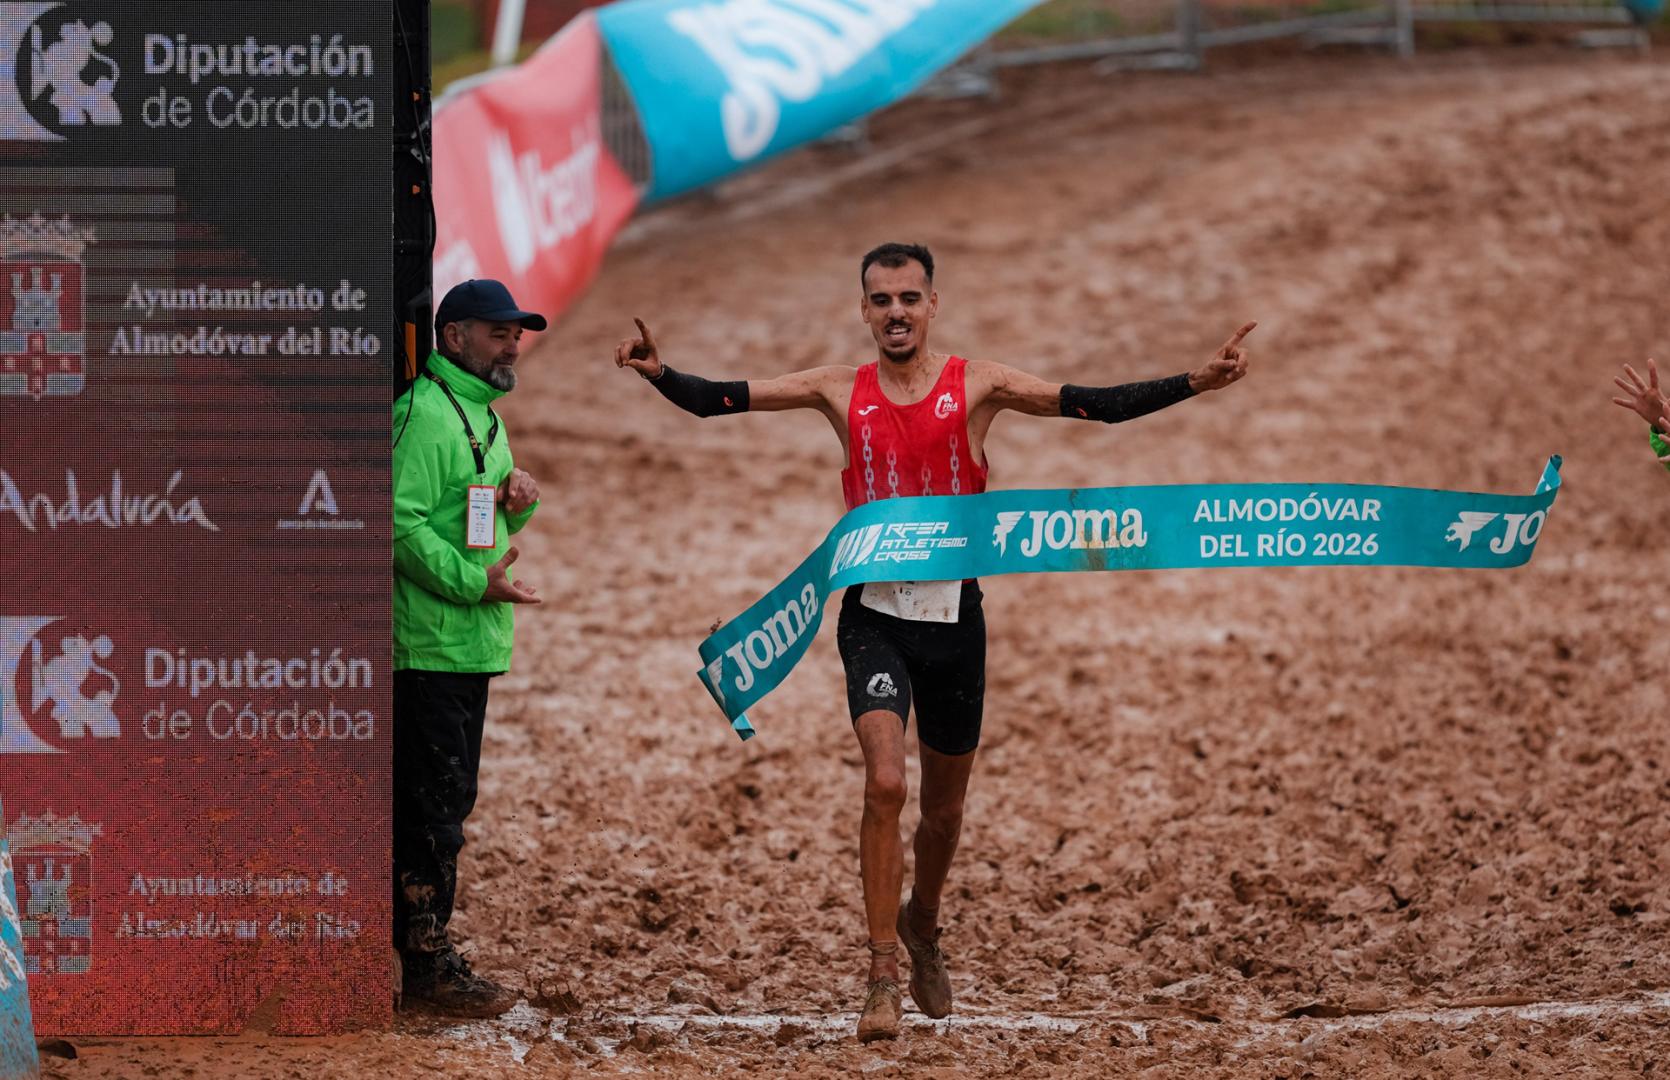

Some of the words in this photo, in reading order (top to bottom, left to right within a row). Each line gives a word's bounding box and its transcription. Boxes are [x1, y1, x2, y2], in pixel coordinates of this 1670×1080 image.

[144, 33, 374, 84] Diputación
[142, 87, 193, 129] de
[206, 86, 375, 129] Córdoba
[122, 281, 325, 317] Ayuntamiento
[331, 279, 368, 311] de
[109, 326, 273, 356] Almodóvar
[276, 326, 323, 356] del
[329, 326, 381, 356] Río
[0, 467, 221, 533] Andalucía
[1193, 491, 1382, 523] ALMODÓVAR
[879, 537, 968, 550] ATLETISMO
[884, 521, 949, 538] RFEA
[1200, 533, 1249, 558] DEL
[1257, 528, 1306, 557] RÍO
[1313, 532, 1379, 557] 2026
[873, 550, 931, 563] CROSS
[144, 648, 373, 698] Diputación
[142, 702, 193, 741] de
[206, 699, 375, 742] Córdoba
